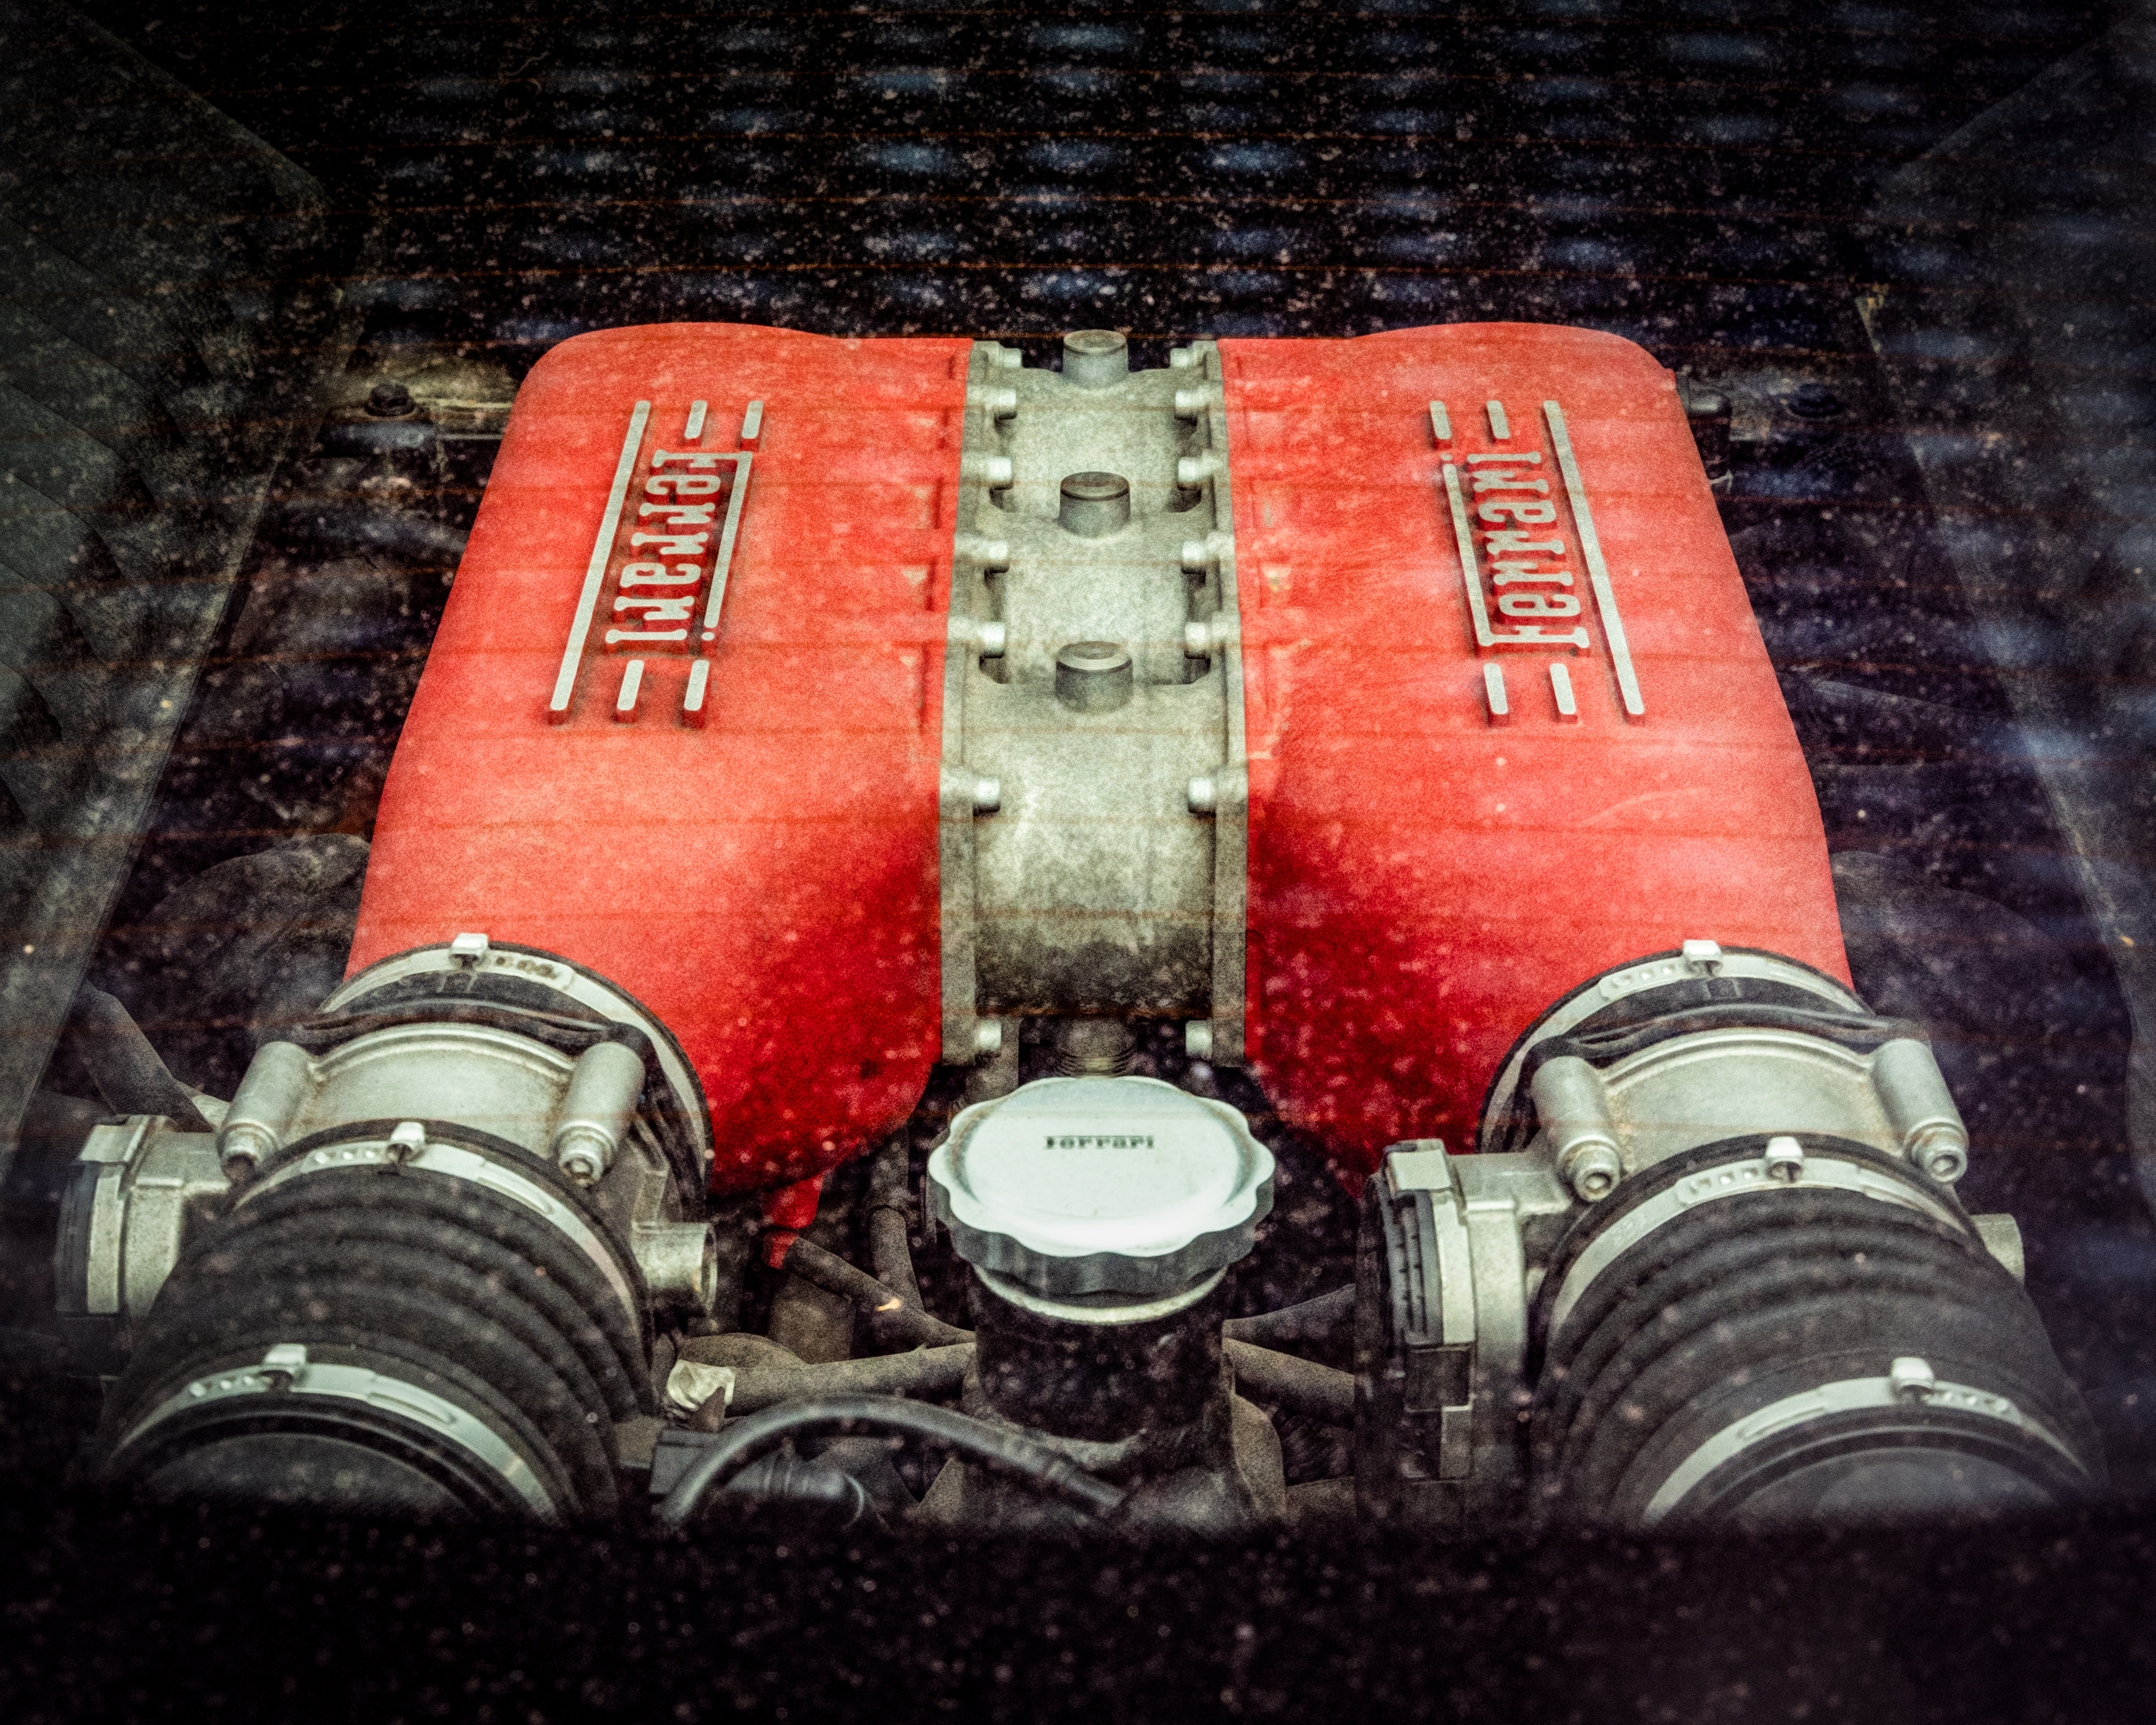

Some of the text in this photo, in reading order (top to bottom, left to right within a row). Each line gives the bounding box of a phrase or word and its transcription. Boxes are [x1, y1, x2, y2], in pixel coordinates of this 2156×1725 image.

[605, 450, 753, 643] Ferrari
[1440, 451, 1589, 649] Ferrari
[1044, 1134, 1155, 1150] Ferrari
